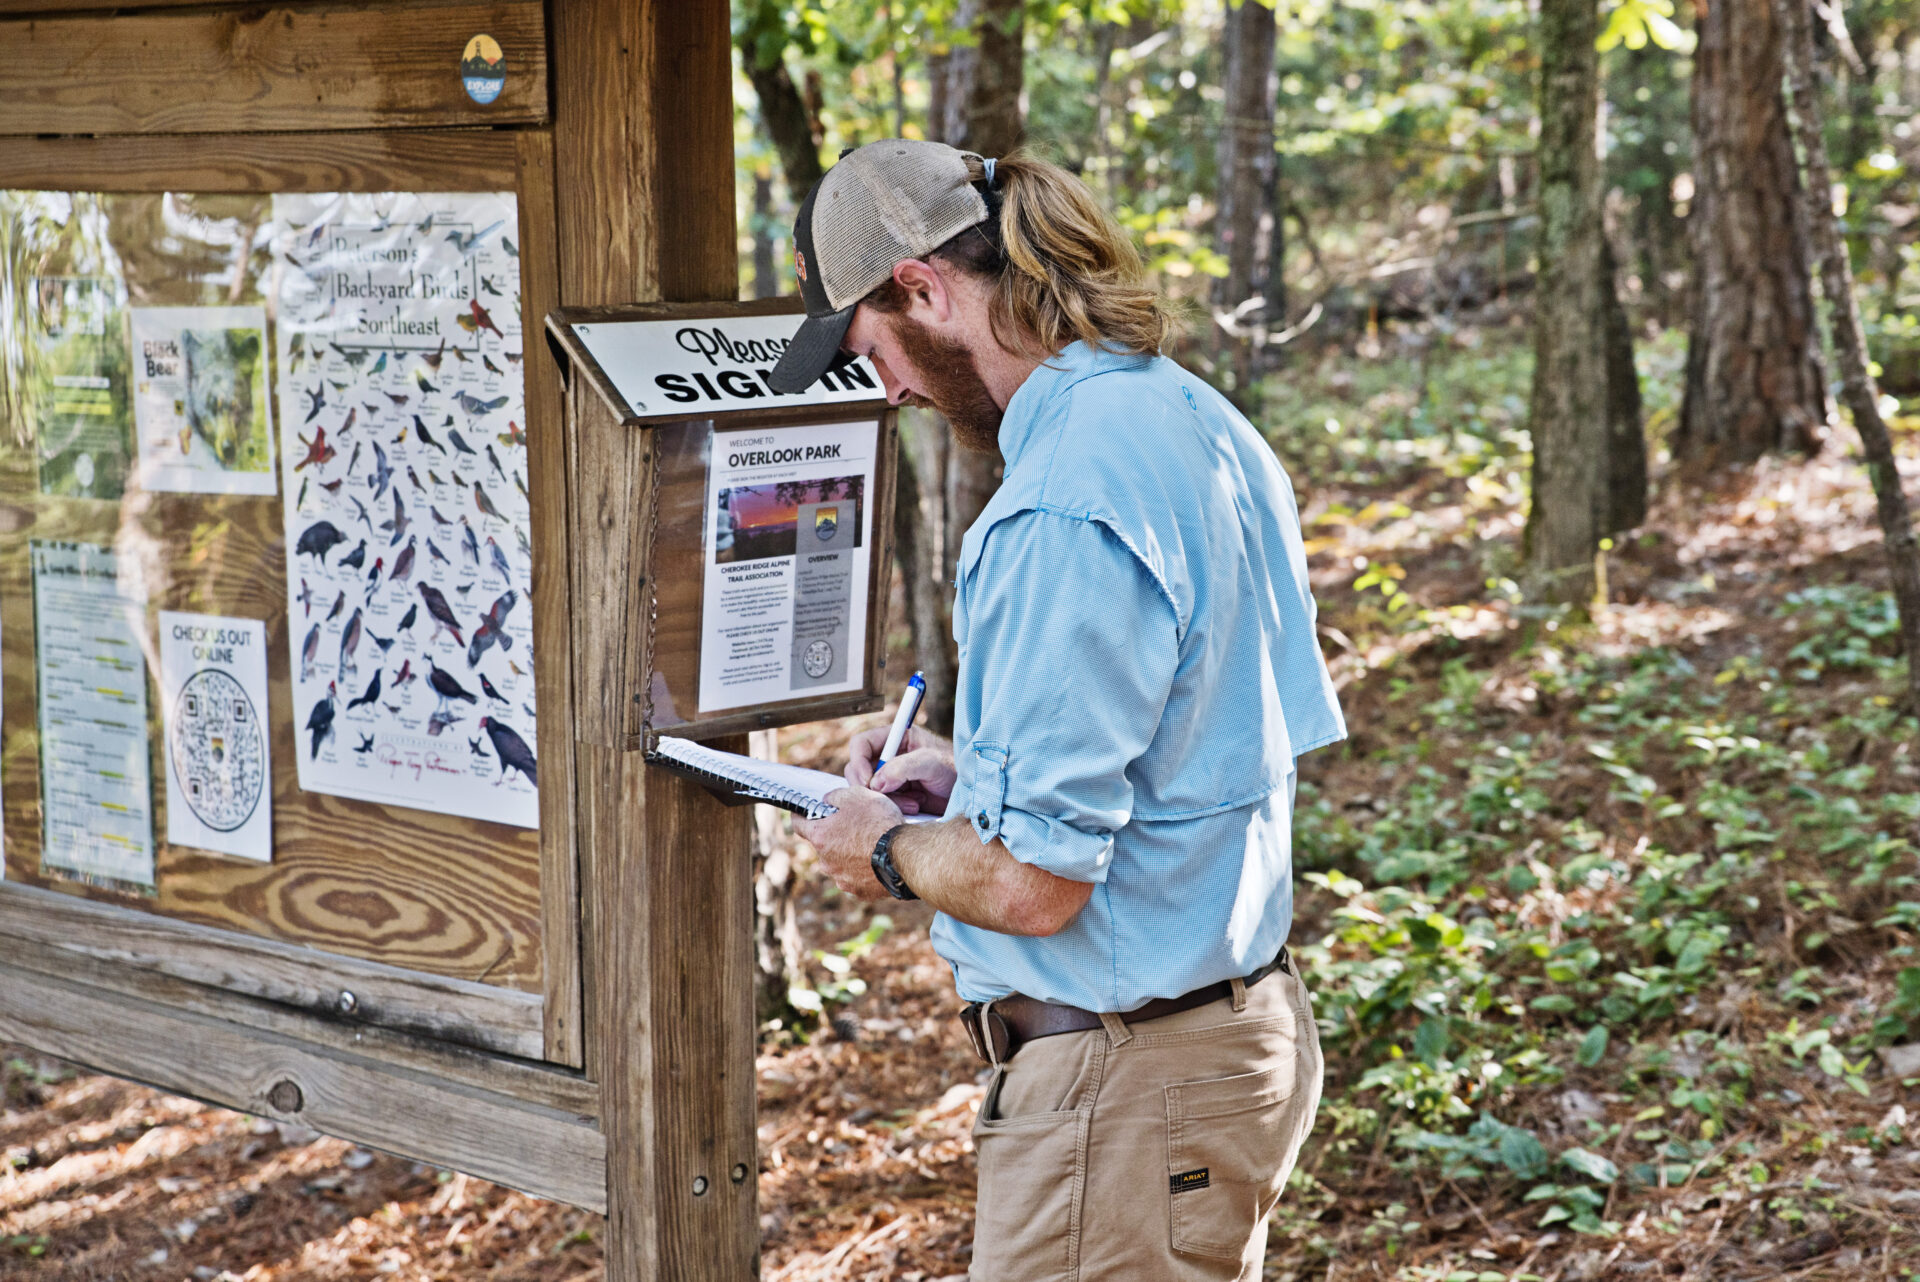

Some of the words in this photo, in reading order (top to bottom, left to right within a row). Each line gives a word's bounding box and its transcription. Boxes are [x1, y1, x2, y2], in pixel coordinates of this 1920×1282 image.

[335, 237, 418, 263] Pterson's
[337, 270, 415, 304] Backyard
[421, 270, 469, 300] Birds
[357, 305, 440, 335] Southeast
[676, 327, 791, 366] Pleas
[729, 437, 764, 447] WELCOME
[765, 436, 774, 445] TO
[728, 447, 803, 467] OVERLOOK
[806, 444, 841, 460] PARK
[721, 564, 751, 573] CHEROKEE
[771, 559, 790, 567] ALPINE
[808, 553, 839, 563] OVERVIEW
[728, 575, 743, 583] TRAIL
[745, 571, 783, 580] ASSOCIATION
[228, 630, 250, 645] OUT
[192, 646, 233, 664] ONLINE
[1184, 1172, 1206, 1181] ARIAT
